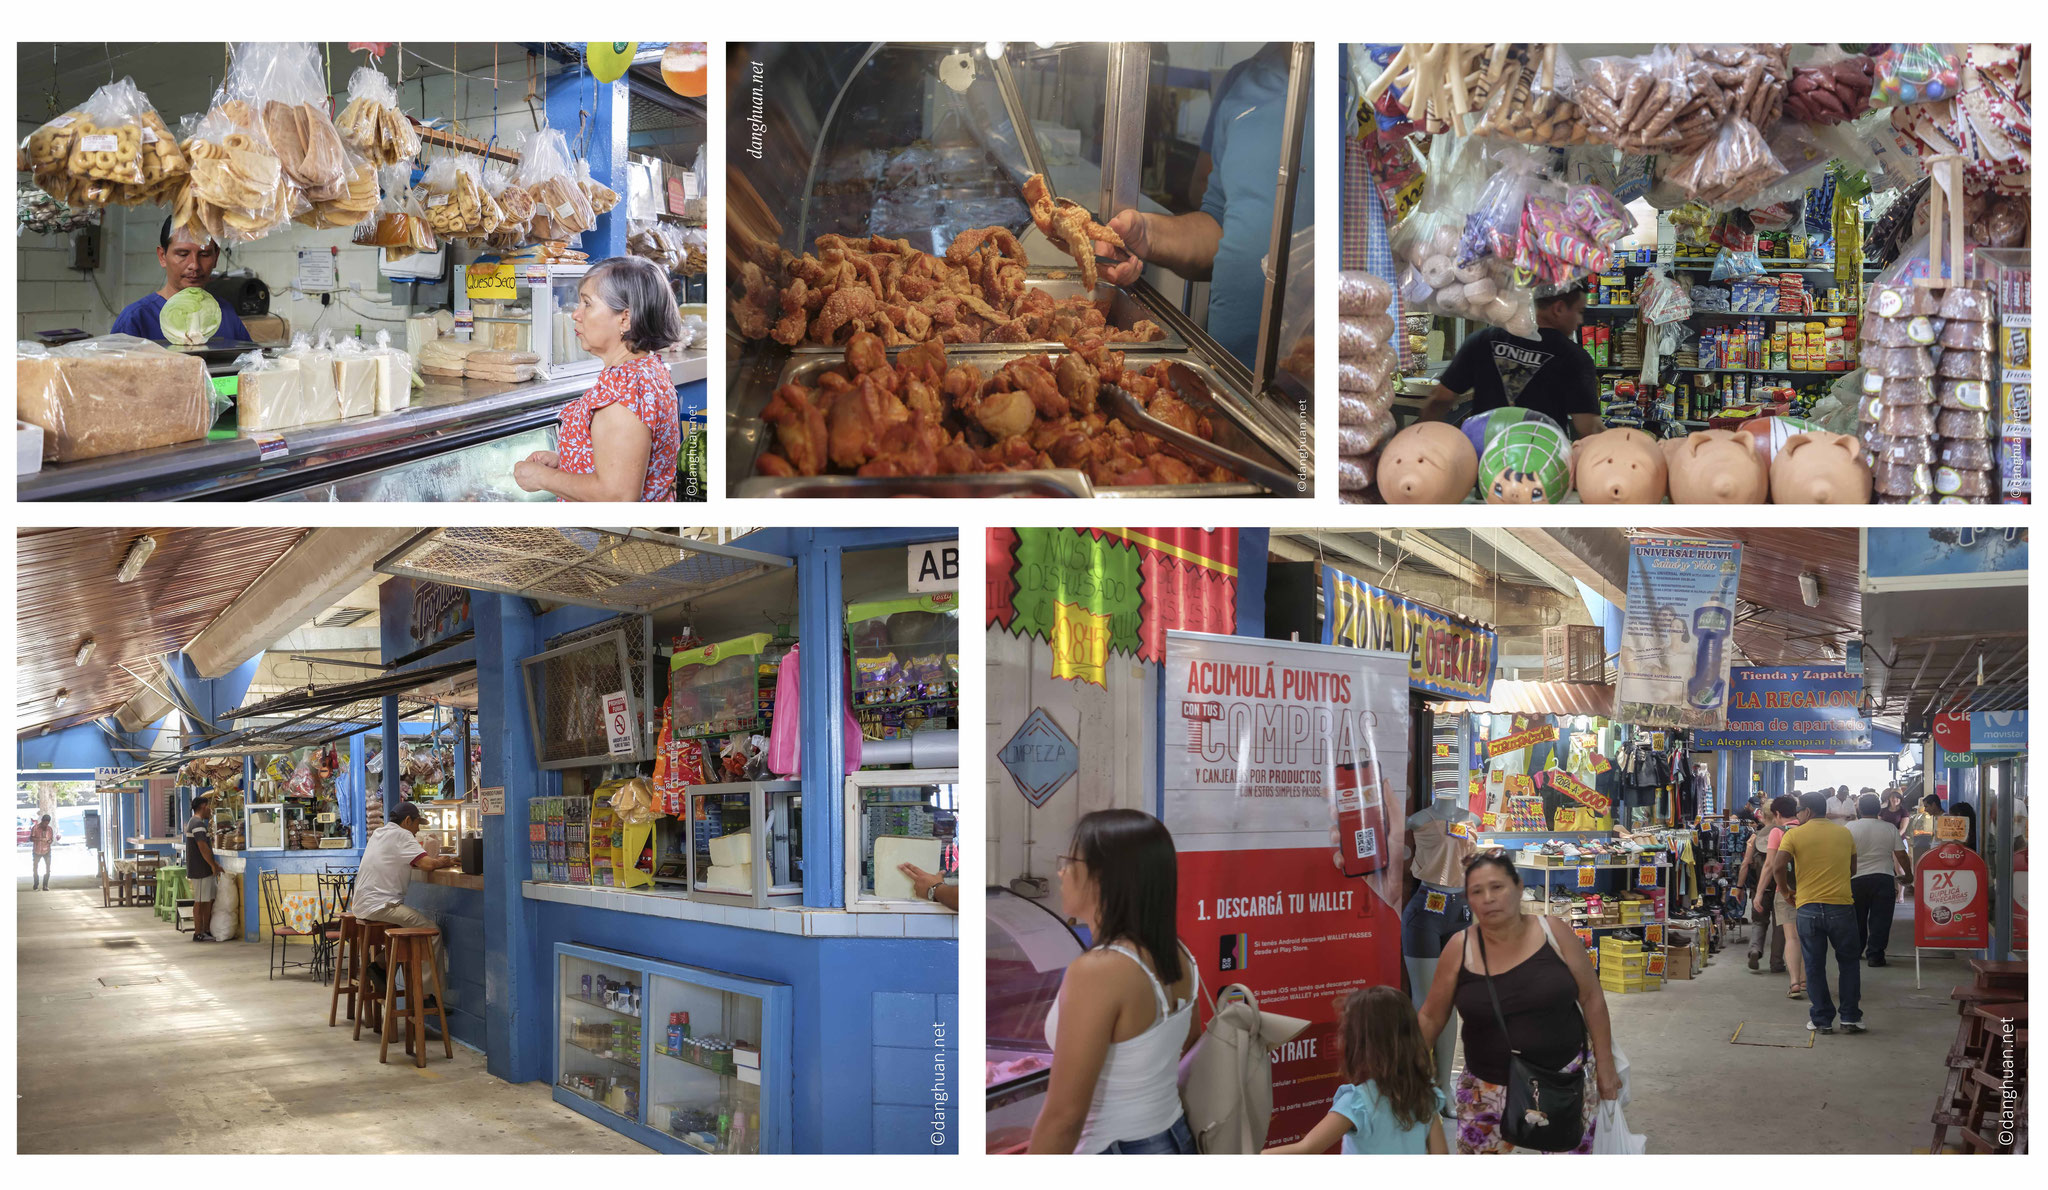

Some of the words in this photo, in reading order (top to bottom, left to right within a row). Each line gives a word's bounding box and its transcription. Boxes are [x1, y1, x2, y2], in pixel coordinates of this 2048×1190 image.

[466, 273, 493, 290] Queso
[495, 272, 516, 289] Seco
[1043, 532, 1107, 579] MUSLO
[1635, 547, 1694, 559] UNIVERSAL
[918, 547, 959, 582] AB
[1652, 558, 1681, 569] Salud
[1691, 560, 1717, 570] Vida
[1028, 562, 1126, 602] DESHUESADO
[1337, 589, 1394, 651] ZONA
[1401, 615, 1422, 669] DE
[1425, 624, 1488, 688] OFERTAS
[1187, 661, 1276, 699] ACUMULÁ
[1282, 669, 1351, 704] PUNTOS
[1740, 671, 1788, 680] Tienda
[1791, 672, 1799, 681] y
[1736, 691, 1762, 709] LA
[1765, 690, 1871, 709] REGALONA
[1183, 704, 1200, 716] CON
[1202, 705, 1218, 717] TUS
[1200, 701, 1378, 766] COMPRAS
[1769, 717, 1788, 732] de
[1792, 717, 1866, 734] apartado
[1700, 738, 1713, 746] La
[1760, 738, 1775, 746] de
[1778, 738, 1826, 748] comprar
[1005, 743, 1066, 764] LIMPIEZA
[1944, 752, 1974, 763] kölbi
[1195, 768, 1201, 783] Y
[1250, 769, 1266, 784] POR
[1269, 769, 1322, 784] PRODUCTOS
[1254, 786, 1274, 798] ESTOS
[1275, 786, 1301, 798] SIMPLES
[1931, 871, 1956, 891] 2X
[1197, 899, 1211, 921] 1.
[1216, 891, 1284, 920] DESCARGÁ
[1289, 893, 1304, 914] TU
[1309, 891, 1354, 913] WALLET
[1254, 940, 1261, 948] Si
[1261, 939, 1278, 947] tenés
[1278, 938, 1301, 946] Android
[1327, 933, 1348, 941] WALLET
[1348, 931, 1373, 939] PASSES
[1254, 948, 1272, 956] desde
[1279, 946, 1292, 954] Play
[1261, 988, 1277, 996] tenés
[1325, 980, 1351, 988] descargar
[1260, 995, 1289, 1004] aplicación
[1289, 992, 1312, 1000] WALLET
[1272, 1079, 1292, 1087] celular
[1286, 1103, 1301, 1111] parte
[1302, 1098, 1325, 1107] superior
[1269, 1138, 1282, 1146] para
[1283, 1135, 1294, 1143] que
